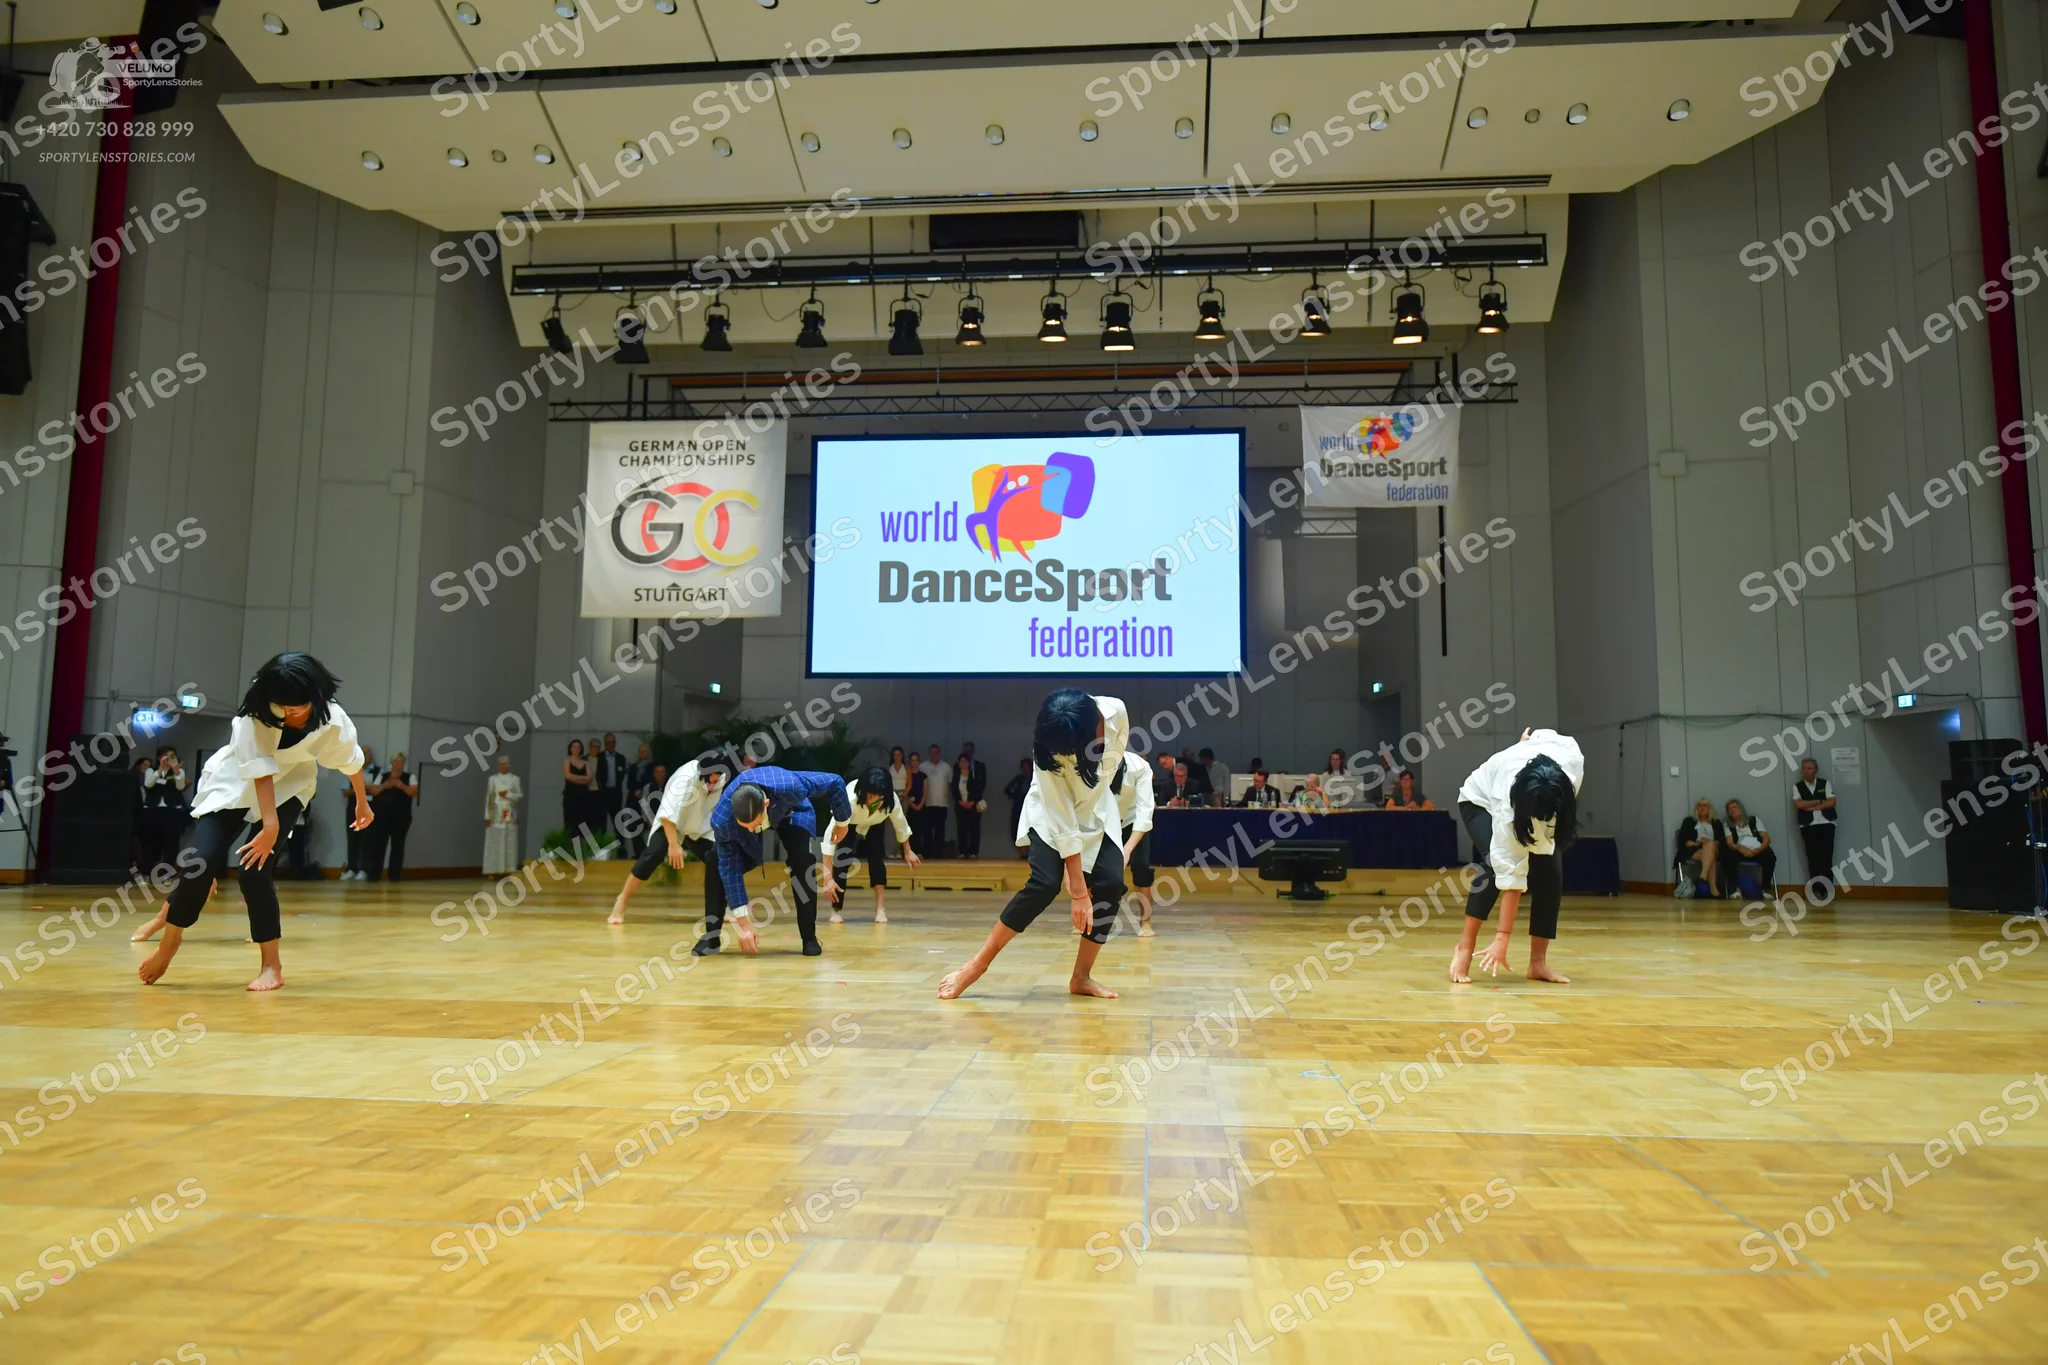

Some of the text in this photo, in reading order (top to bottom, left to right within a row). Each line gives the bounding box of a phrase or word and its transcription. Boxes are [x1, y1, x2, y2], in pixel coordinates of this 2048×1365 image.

[629, 439, 746, 452] GERMAN OPEN
[1319, 432, 1354, 451] world
[619, 454, 756, 467] CHAMPIONSHIPS
[1320, 457, 1448, 481] DanceSport
[1386, 483, 1448, 502] federation
[880, 500, 958, 542] world
[878, 558, 1173, 612] DanceSport
[1028, 616, 1173, 658] federation
